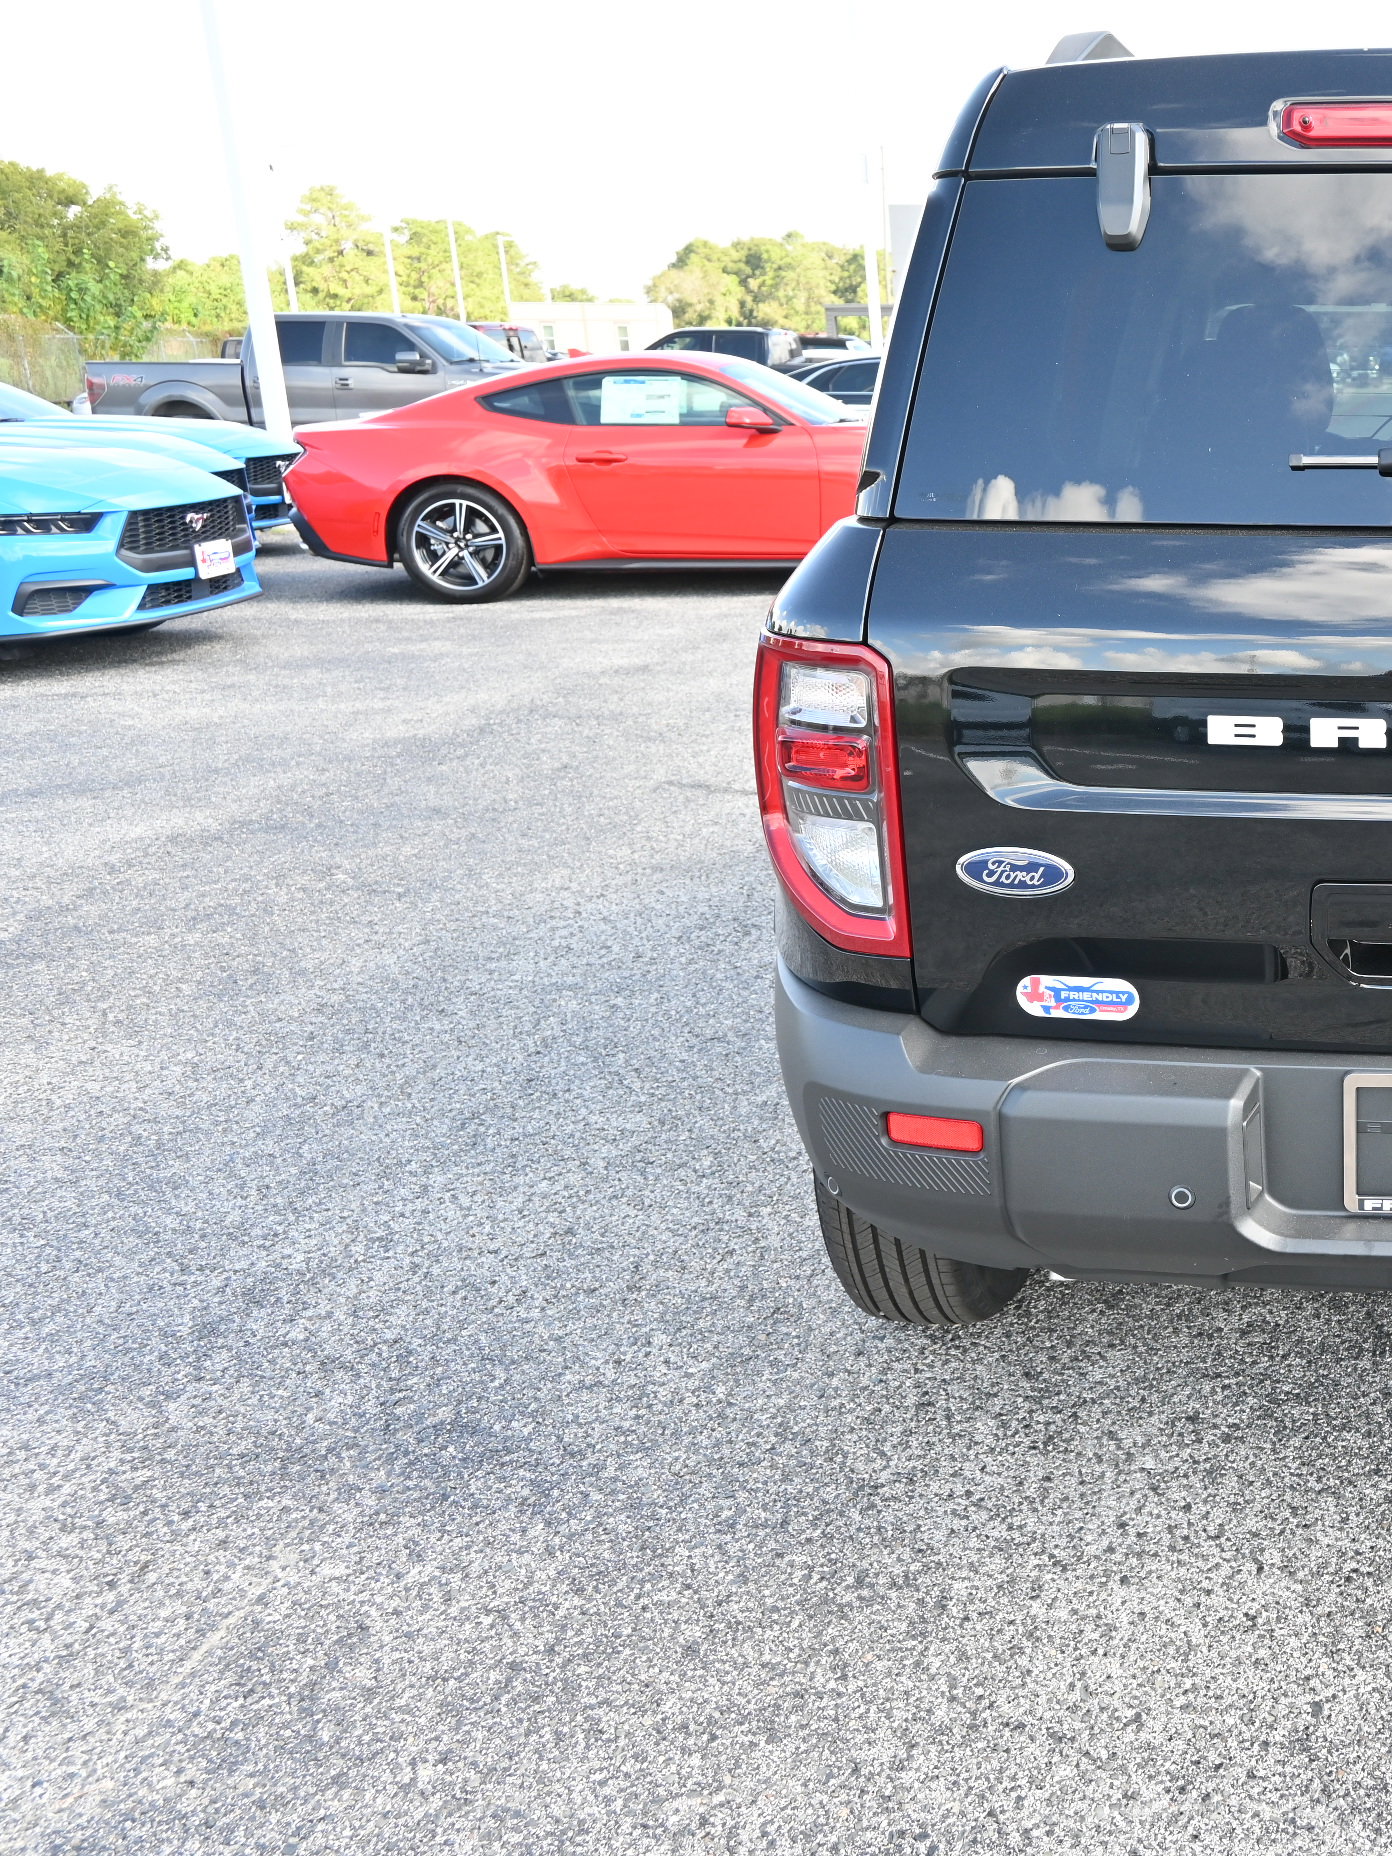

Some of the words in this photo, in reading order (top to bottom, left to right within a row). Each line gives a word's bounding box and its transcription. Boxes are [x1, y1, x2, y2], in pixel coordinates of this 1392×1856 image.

[982, 857, 1046, 886] Ford
[1060, 990, 1129, 1003] FRIENDLY
[1068, 1003, 1091, 1014] Ford
